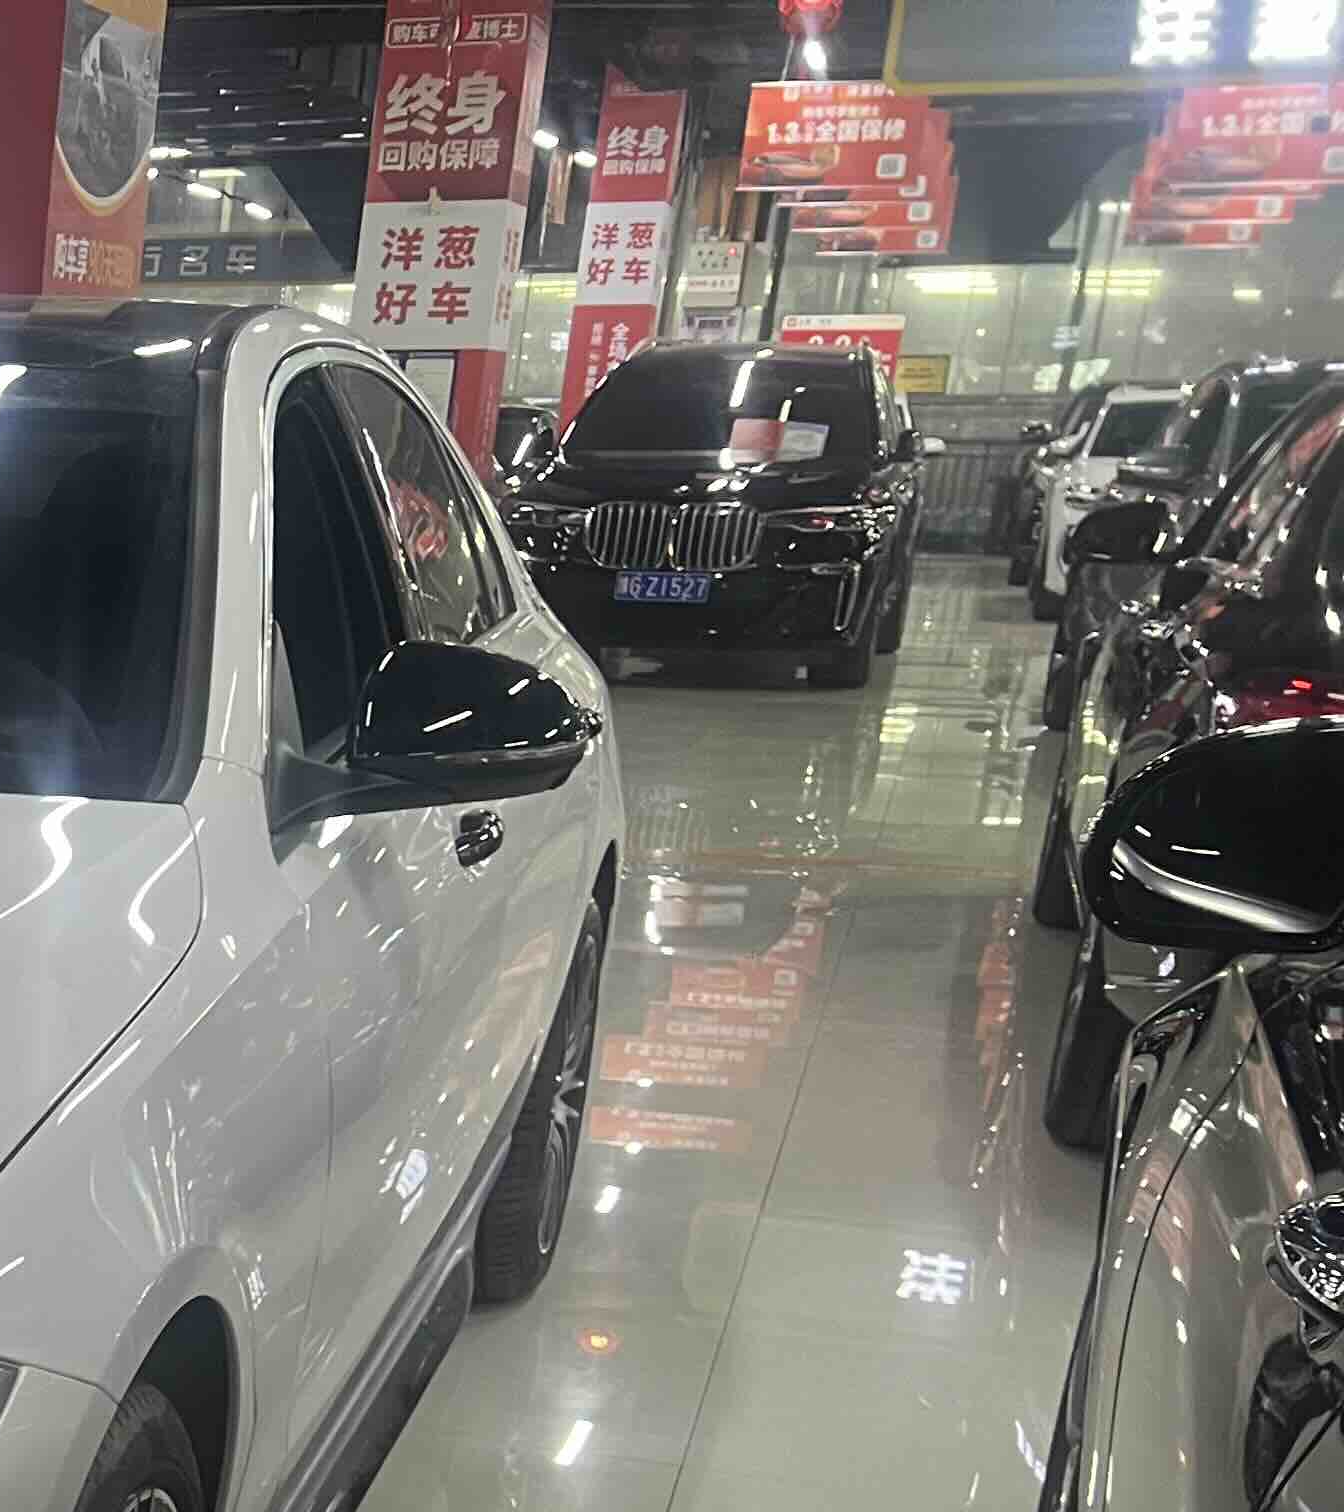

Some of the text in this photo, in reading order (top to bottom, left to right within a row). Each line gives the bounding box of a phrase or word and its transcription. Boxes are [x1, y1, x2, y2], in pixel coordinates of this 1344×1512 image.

[384, 70, 507, 135] 终身
[377, 137, 500, 173] 回购保障
[605, 125, 670, 159] 终身
[379, 225, 481, 272] 洋葱
[591, 221, 657, 249] 洋葱
[585, 255, 651, 286] 好车
[372, 282, 473, 326] 好车
